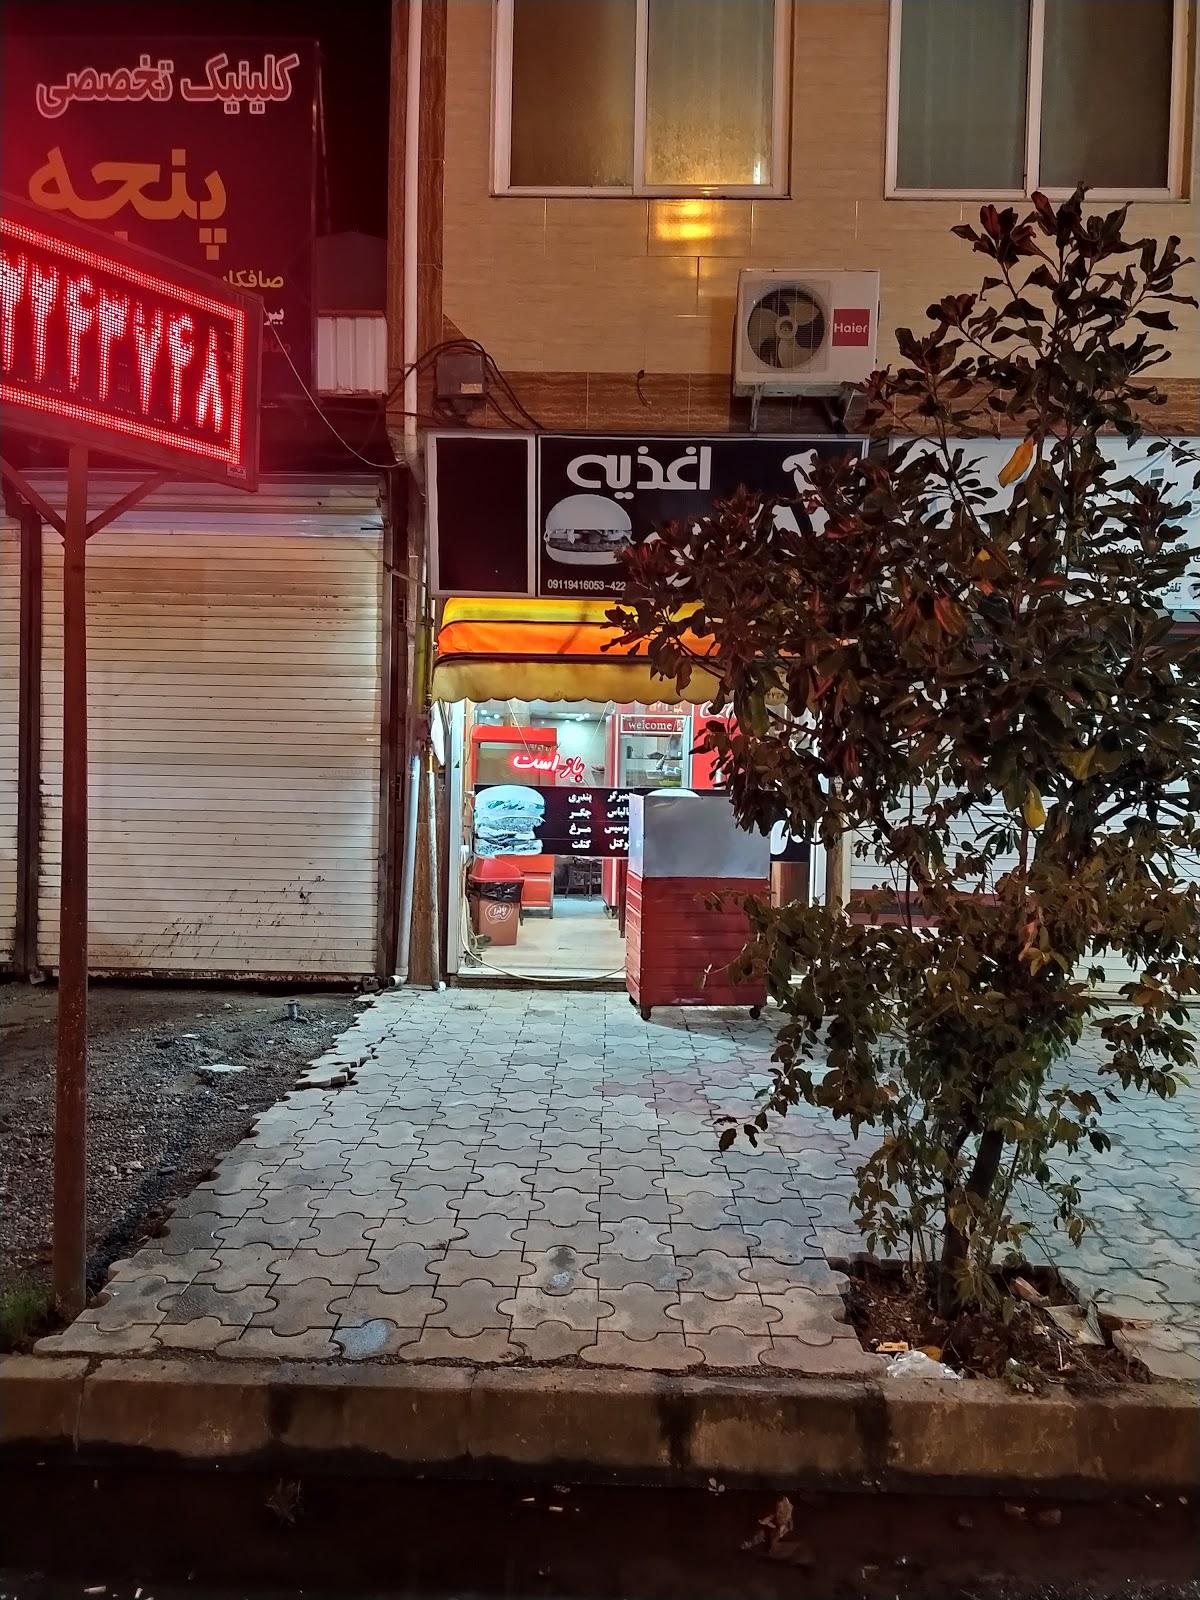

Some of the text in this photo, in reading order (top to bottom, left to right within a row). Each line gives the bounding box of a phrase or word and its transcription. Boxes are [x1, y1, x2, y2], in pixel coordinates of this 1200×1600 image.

[36, 53, 300, 119] کلینیک تخصصی
[28, 145, 227, 261] پنجه
[222, 269, 284, 289] صافکا
[834, 323, 867, 333] Haier
[566, 445, 713, 500] اغذیه
[513, 753, 585, 783] باز است
[607, 806, 630, 818] الباس
[568, 822, 592, 835] مرغ
[604, 825, 630, 834] وسیس
[609, 838, 630, 851] وکتل
